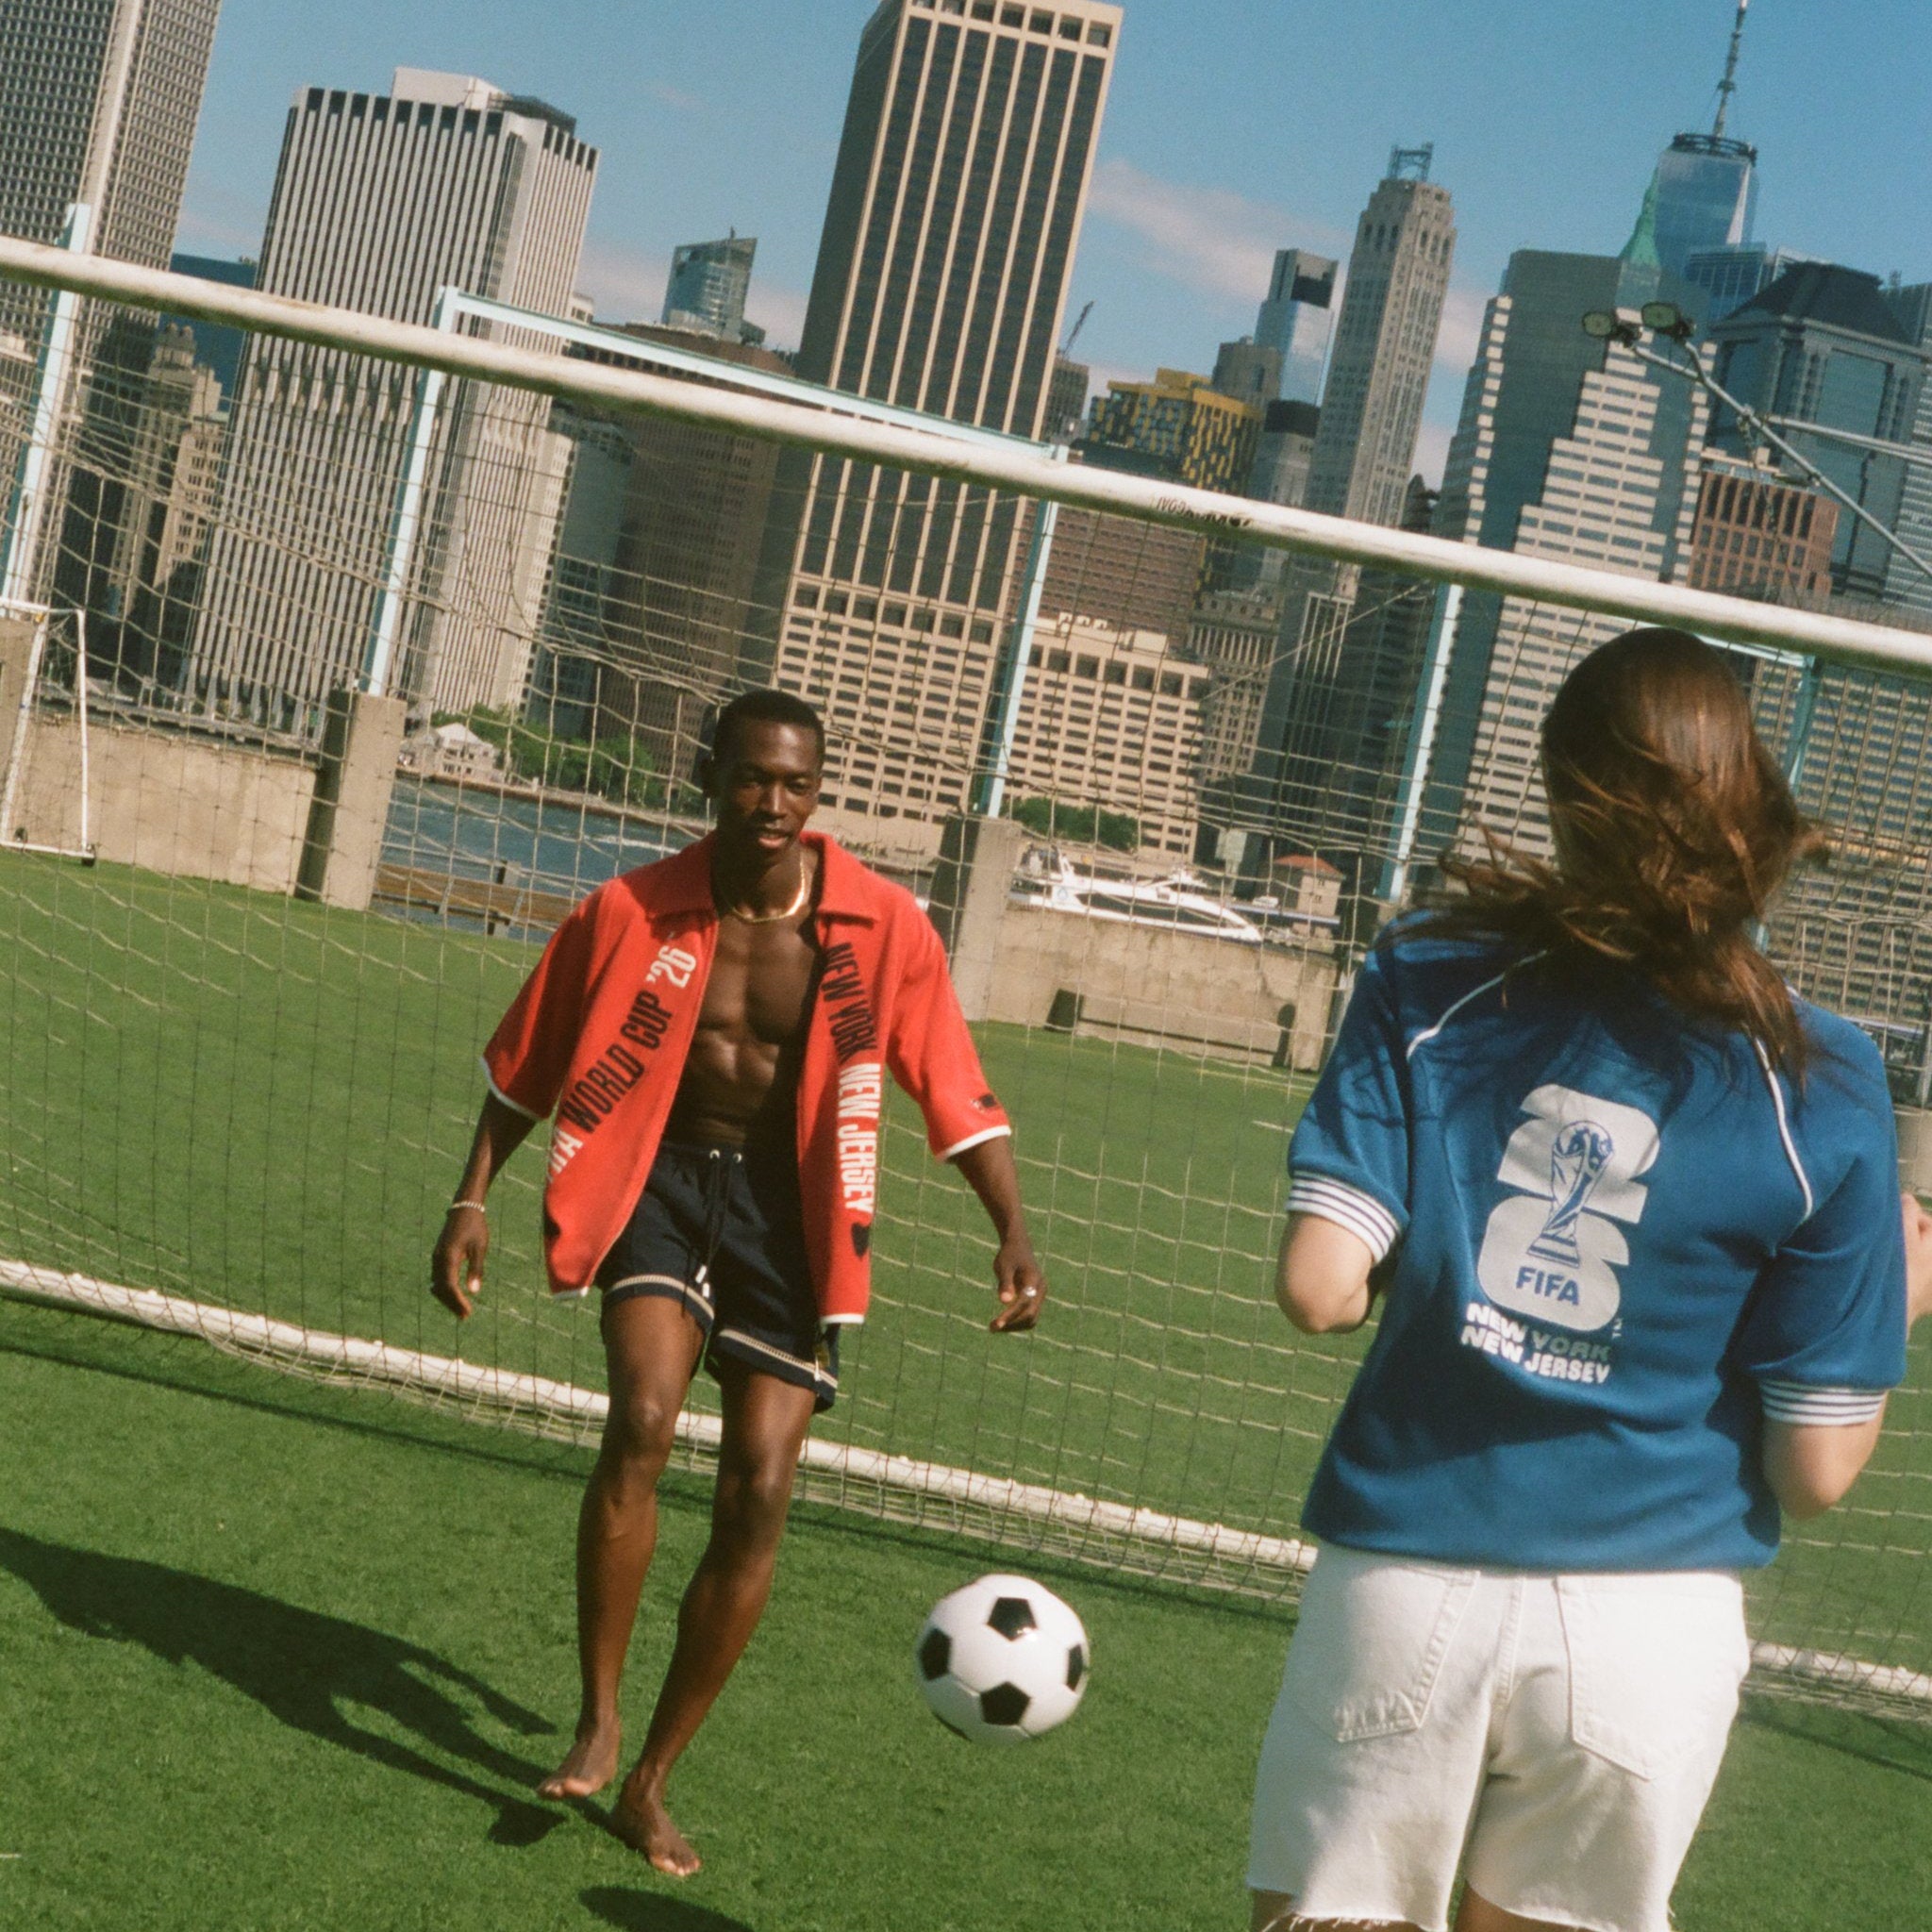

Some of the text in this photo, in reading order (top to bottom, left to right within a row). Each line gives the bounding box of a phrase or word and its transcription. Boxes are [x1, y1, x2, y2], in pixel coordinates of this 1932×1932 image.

[645, 944, 696, 989] '26
[620, 990, 673, 1051] CUP
[560, 1042, 645, 1134] WORLD
[821, 942, 881, 1215] NEW YORK NEW JERSEY
[1515, 1266, 1579, 1306] FIFA
[1461, 1324, 1610, 1384] NEW JERSEY
[1466, 1302, 1611, 1362] NEW YORK
